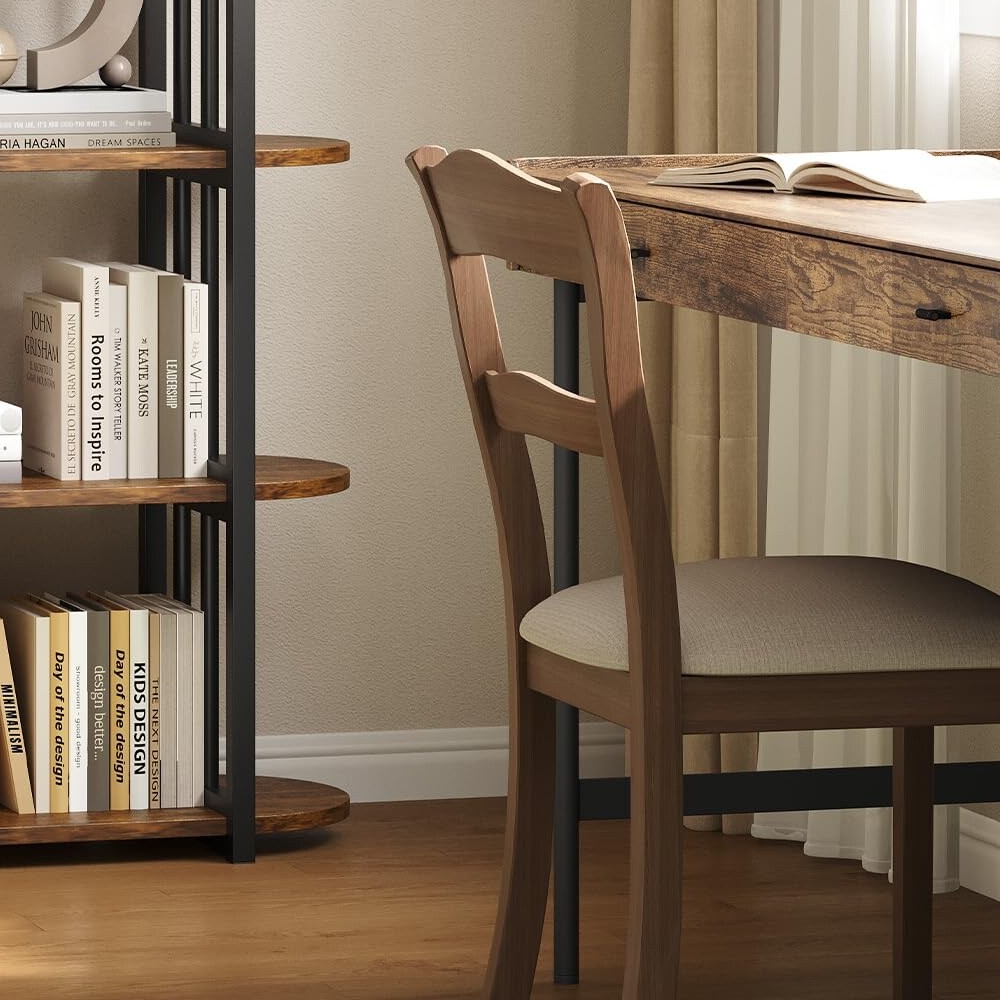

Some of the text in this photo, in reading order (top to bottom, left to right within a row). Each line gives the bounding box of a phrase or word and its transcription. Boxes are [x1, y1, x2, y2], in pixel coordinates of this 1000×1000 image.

[24, 138, 66, 149] HAGAN
[88, 139, 122, 147] DREAM
[127, 138, 161, 147] SPACES
[24, 335, 59, 363] GRISHAM
[31, 311, 53, 333] JOHN
[67, 313, 76, 370] MOUNTAIN
[67, 373, 76, 399] GRAY
[67, 403, 76, 416] DE
[87, 335, 106, 472] Rooms to Inspire
[114, 338, 122, 441] TIM WALKER STORY TELLER
[138, 348, 149, 418] KATE MOSS
[166, 359, 178, 409] LEADERSHIP
[190, 360, 202, 419] WHITE
[67, 418, 76, 461] SECRETO
[91, 665, 106, 709] design
[1, 684, 24, 754] MINIMALISM
[53, 652, 65, 786] Day of the design
[114, 650, 126, 784] Day of the design
[134, 663, 146, 775] KIDS DESIGN
